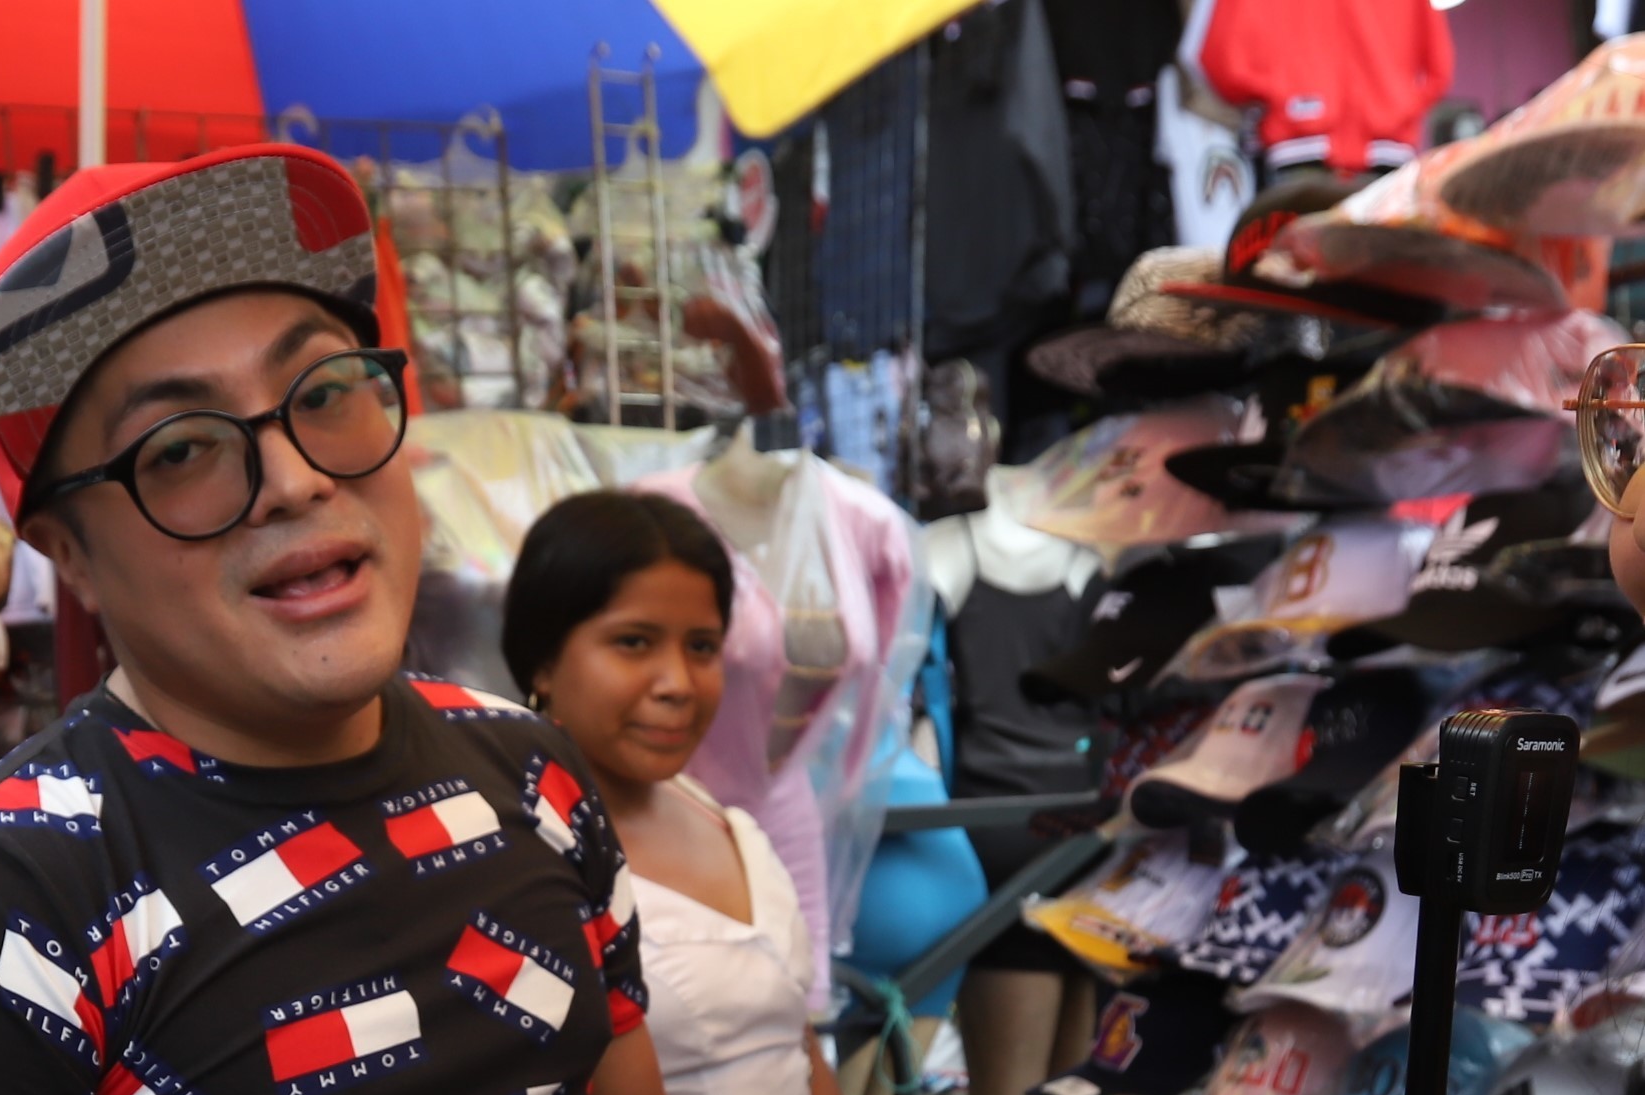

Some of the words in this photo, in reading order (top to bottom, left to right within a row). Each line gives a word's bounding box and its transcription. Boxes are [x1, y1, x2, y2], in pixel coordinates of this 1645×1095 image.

[1517, 737, 1565, 752] Saramonic
[1469, 782, 1478, 797] SET
[206, 810, 317, 876] TOMMY
[416, 834, 505, 874] TOMMY
[254, 862, 369, 931] HILFIGER
[18, 918, 88, 987] TOM
[477, 912, 574, 980] HILFIGER
[270, 975, 396, 1021] HILFIGER
[451, 975, 551, 1042] TOMMY
